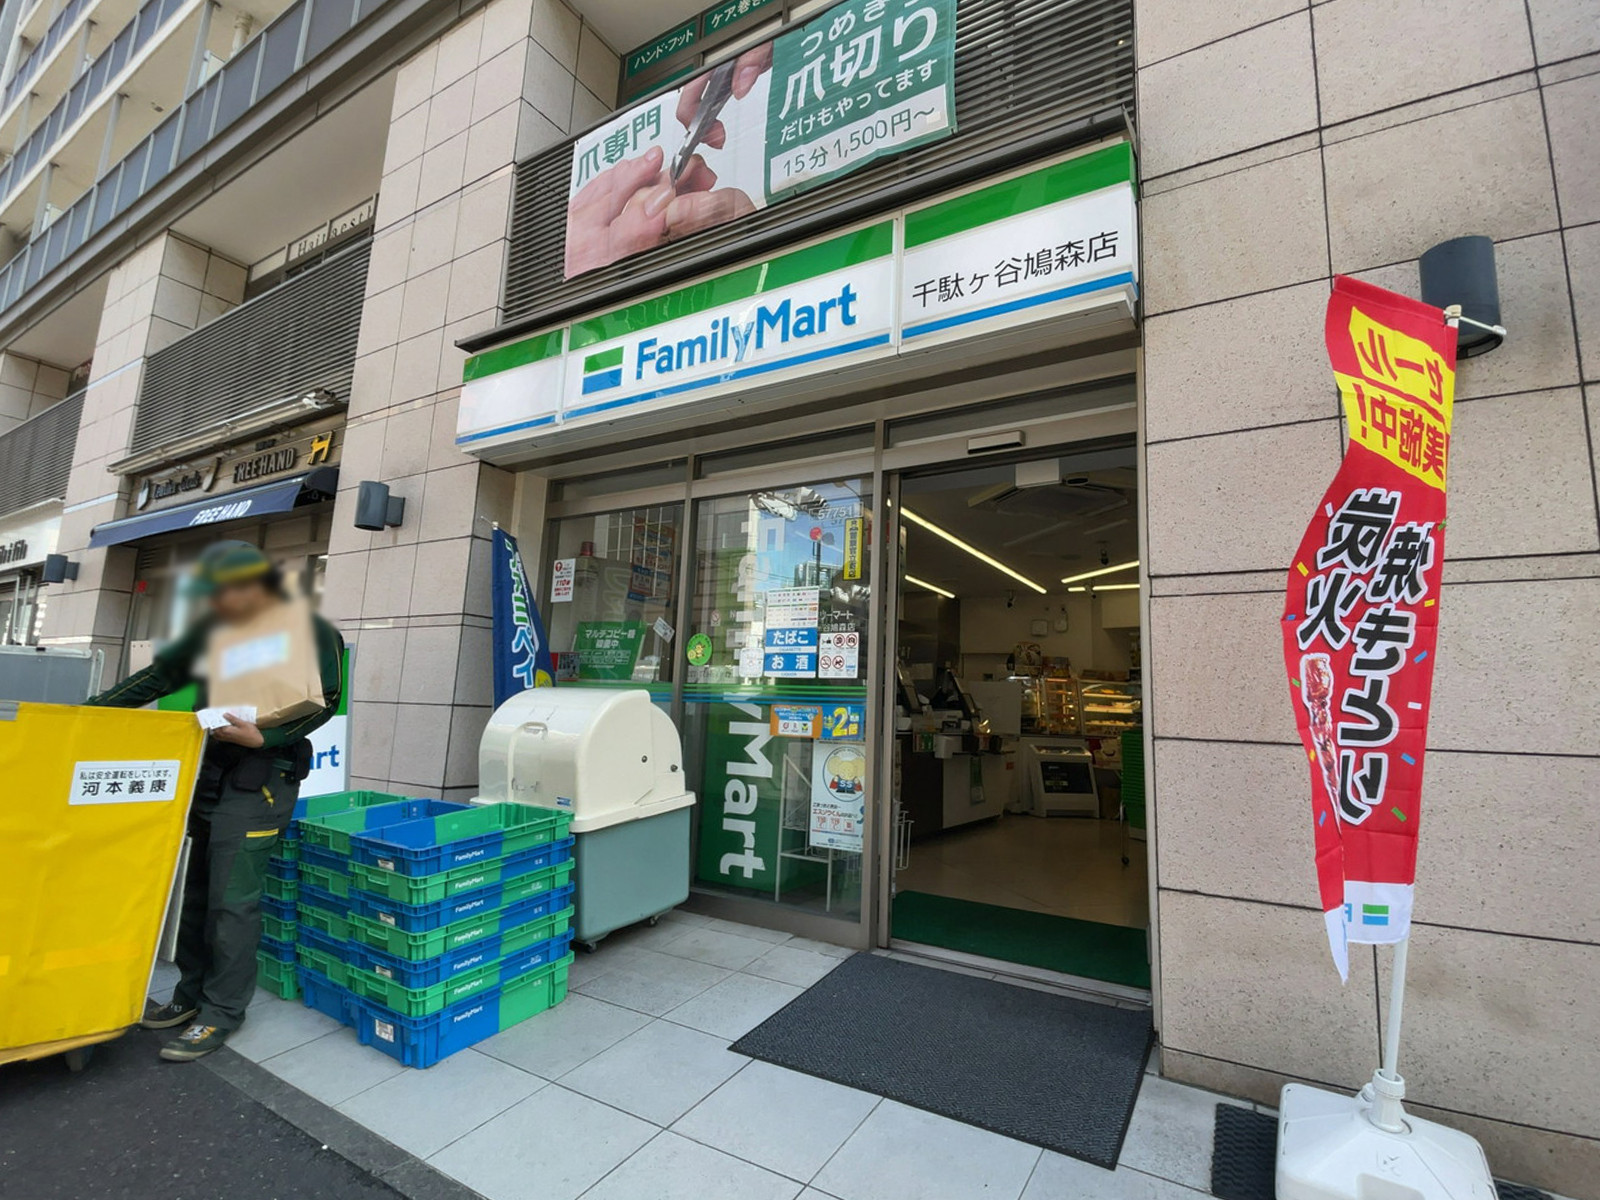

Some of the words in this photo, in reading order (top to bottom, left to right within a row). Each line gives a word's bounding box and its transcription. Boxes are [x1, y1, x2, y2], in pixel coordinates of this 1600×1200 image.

[801, 0, 917, 58] つめき
[634, 29, 694, 69] ハンド・フット
[779, 7, 938, 119] 爪切り
[780, 58, 938, 145] だけもやってます
[576, 104, 662, 187] 爪専門
[636, 283, 857, 380] FamilyMart
[233, 448, 297, 484] FREEHAND
[188, 499, 253, 526] FREEHAND
[773, 630, 809, 645] たばこ
[771, 654, 809, 670] お酒
[455, 849, 484, 862] FamilyMart
[455, 876, 484, 889] FamilyMart
[455, 899, 484, 913] FamilyMart
[454, 928, 483, 943] FamilyMart
[453, 955, 483, 971] FamilyMart
[453, 979, 483, 995] FamilyMart
[454, 1006, 483, 1023] FamilyMart
